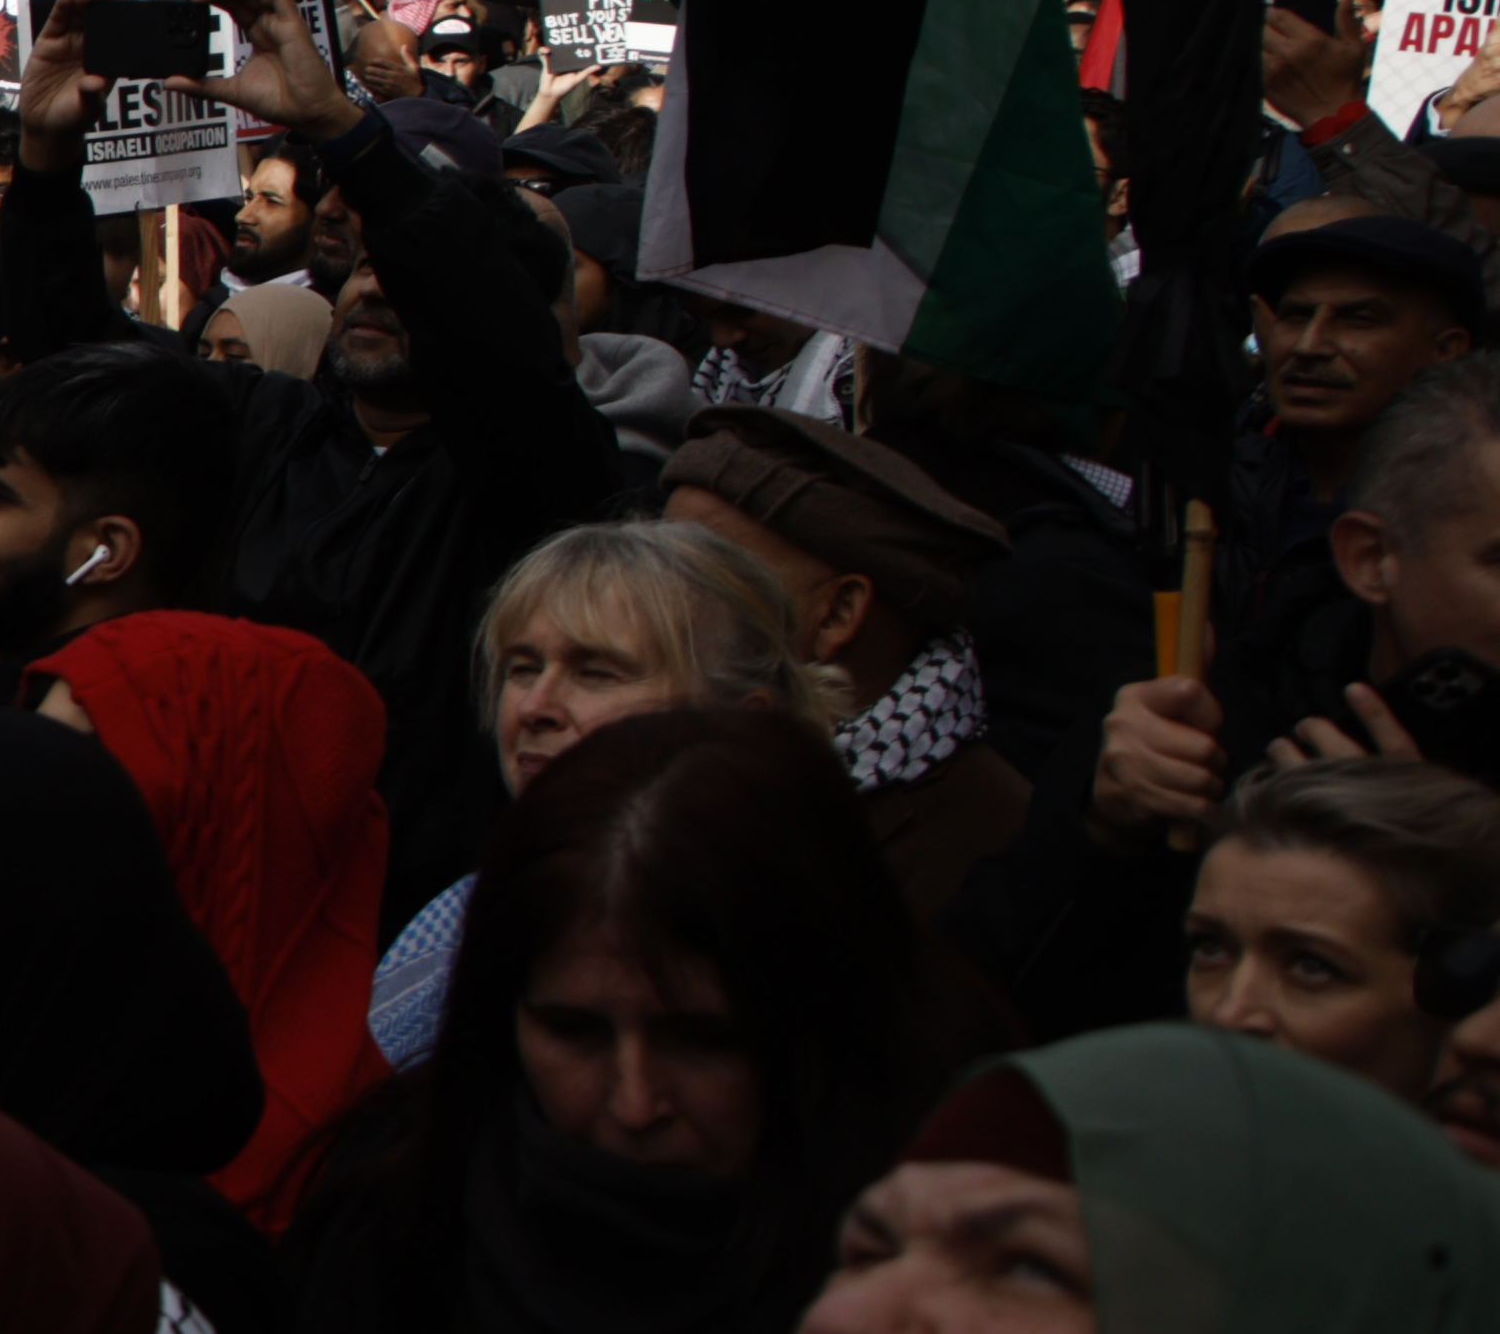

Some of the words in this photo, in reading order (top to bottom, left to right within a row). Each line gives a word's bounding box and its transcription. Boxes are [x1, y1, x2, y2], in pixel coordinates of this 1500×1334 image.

[544, 12, 580, 28] BUT
[586, 8, 616, 26] YOU
[548, 23, 595, 46] SELL
[574, 48, 593, 59] to
[86, 135, 151, 162] ISRAELI
[155, 124, 226, 155] OCCUPATION
